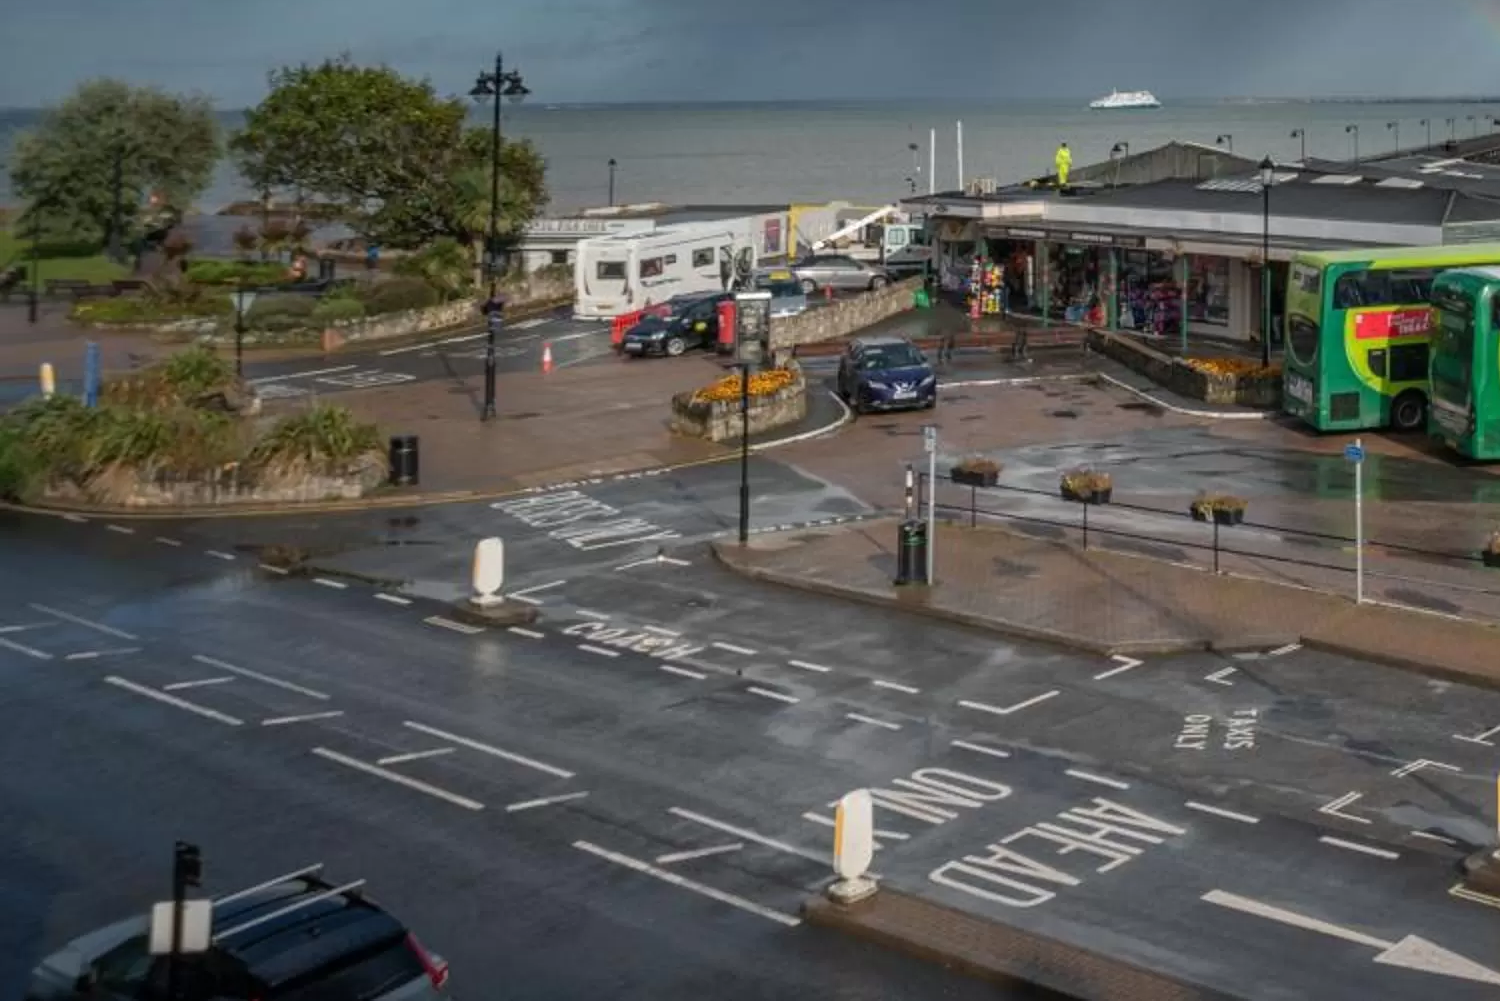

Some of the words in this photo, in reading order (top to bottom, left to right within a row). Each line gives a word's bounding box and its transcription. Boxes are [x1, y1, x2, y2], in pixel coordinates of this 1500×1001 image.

[561, 621, 705, 661] COACH
[1172, 713, 1213, 751] ONLY
[1222, 708, 1258, 751] TAXIS
[928, 796, 1188, 909] AHEAD
